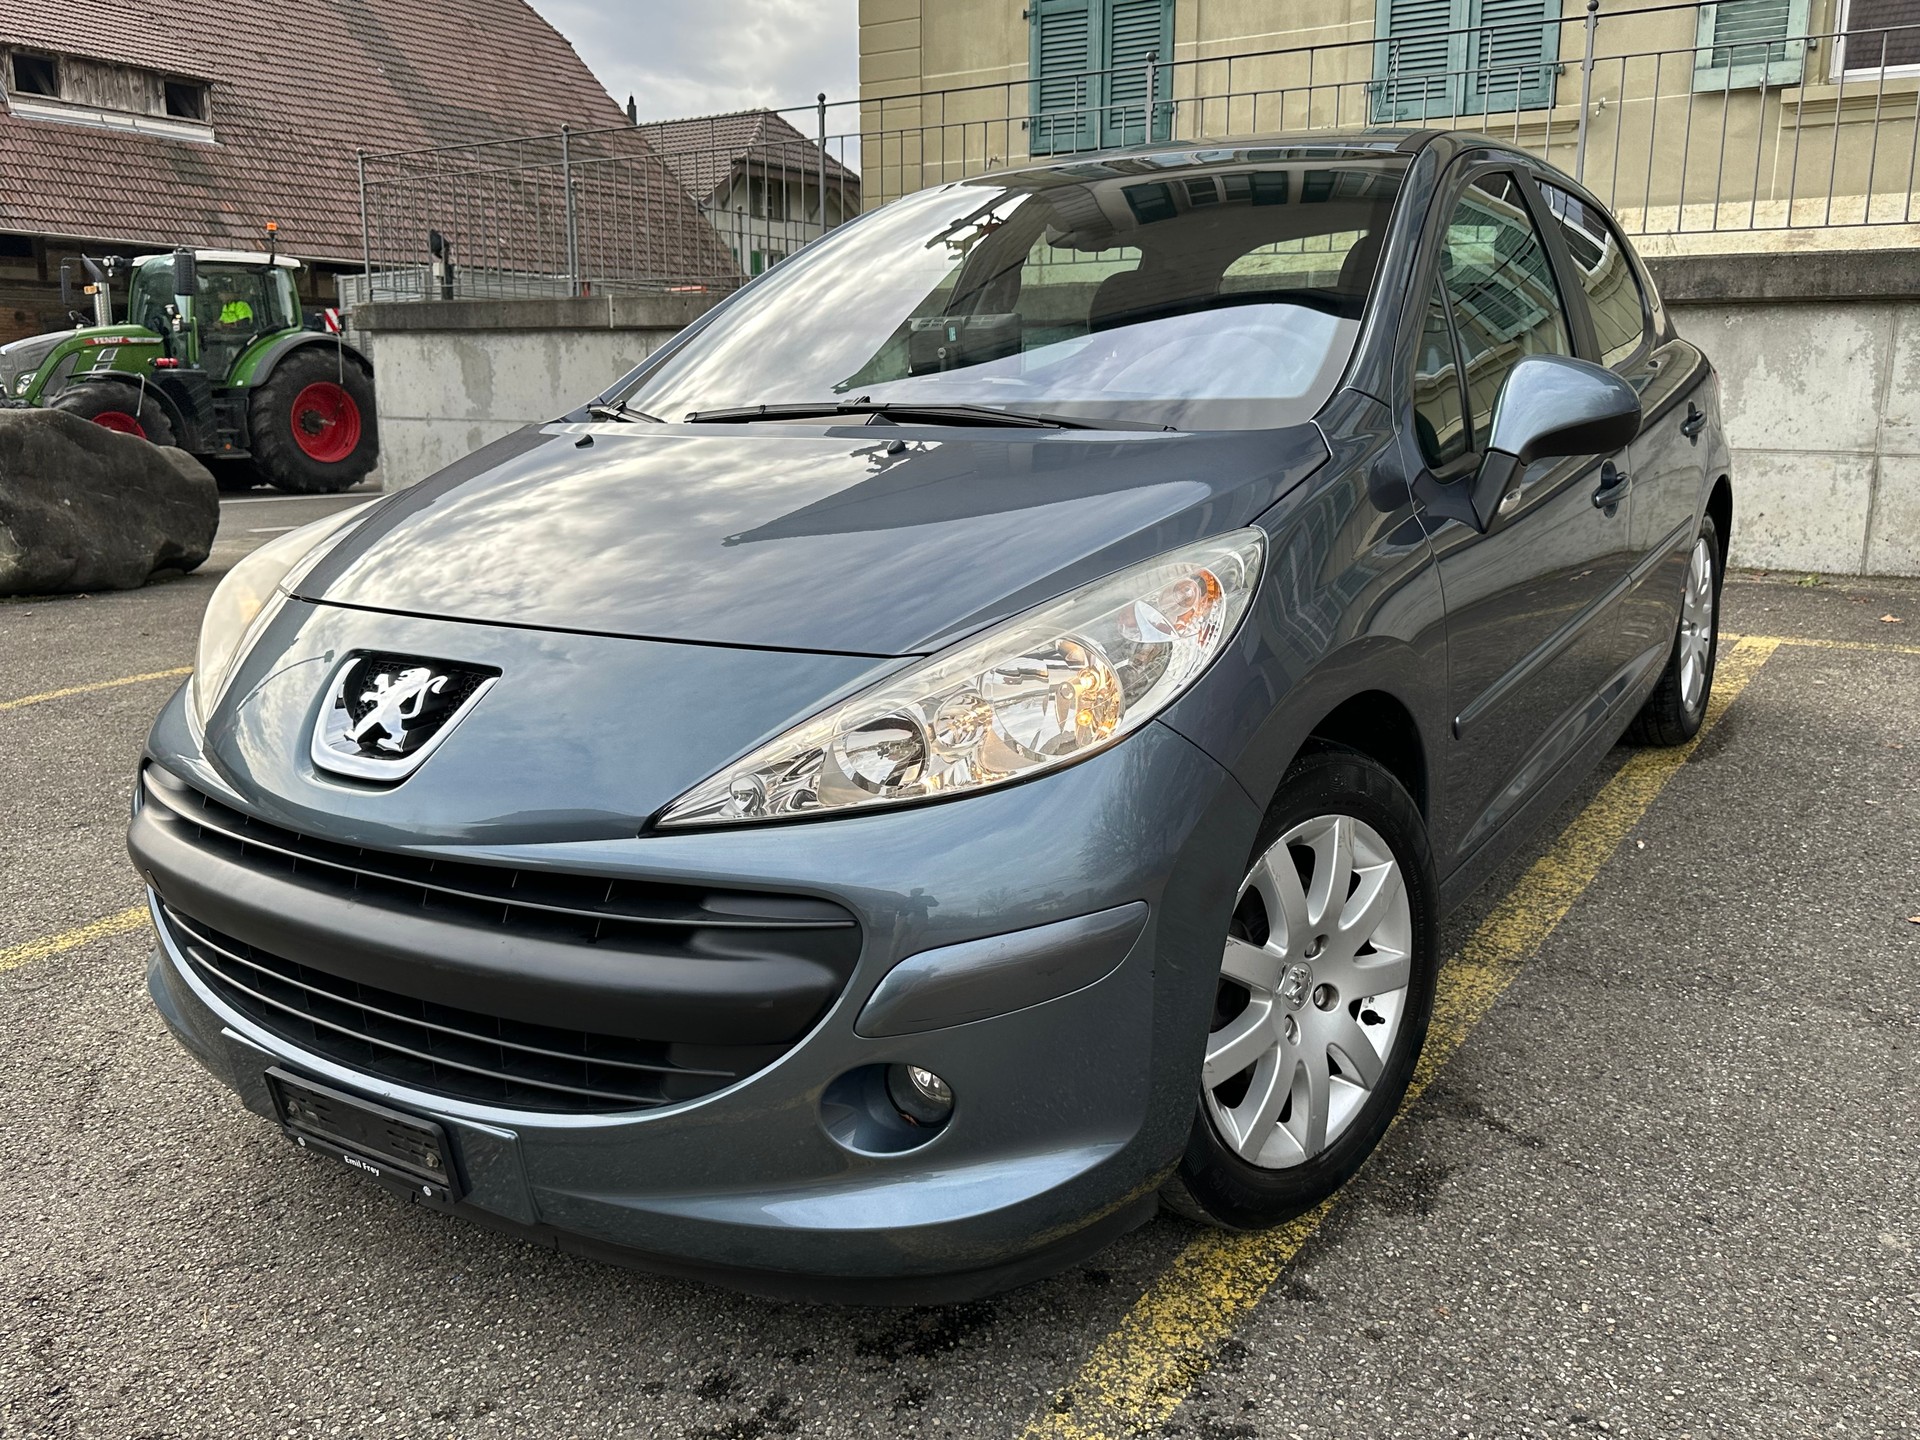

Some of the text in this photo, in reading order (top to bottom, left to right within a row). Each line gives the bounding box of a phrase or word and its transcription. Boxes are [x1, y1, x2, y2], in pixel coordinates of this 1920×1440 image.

[93, 336, 123, 344] FENDT
[343, 1155, 380, 1177] Emil Frey
